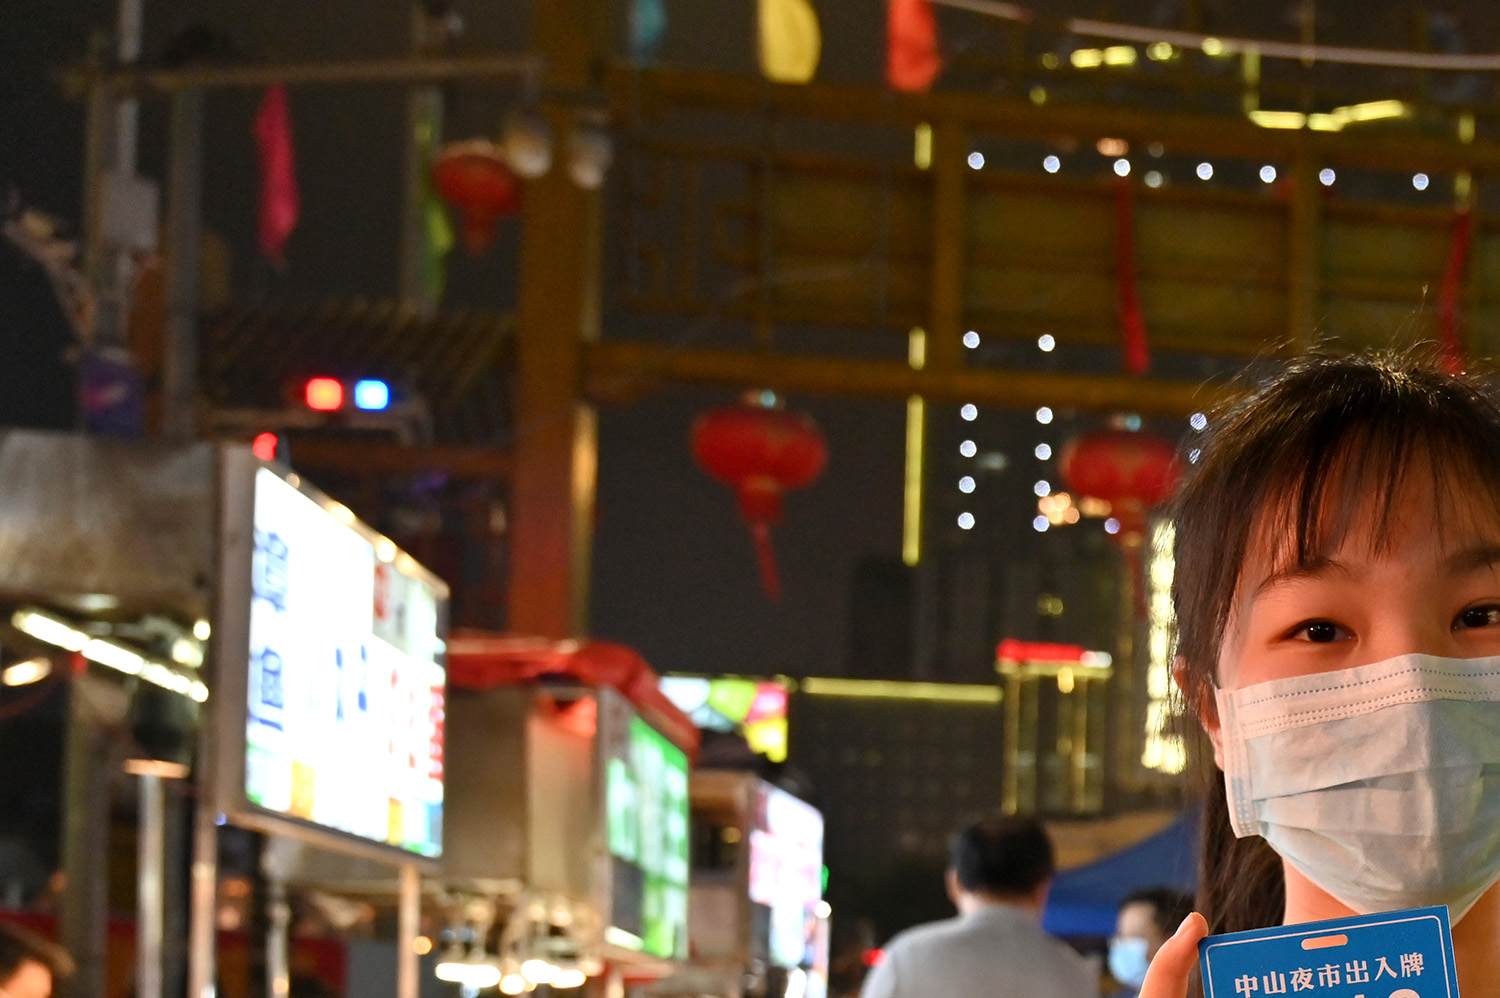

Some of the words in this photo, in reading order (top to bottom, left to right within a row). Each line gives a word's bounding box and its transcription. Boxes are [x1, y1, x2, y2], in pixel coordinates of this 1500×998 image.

[1234, 952, 1425, 998] 中山夜市出入牌
